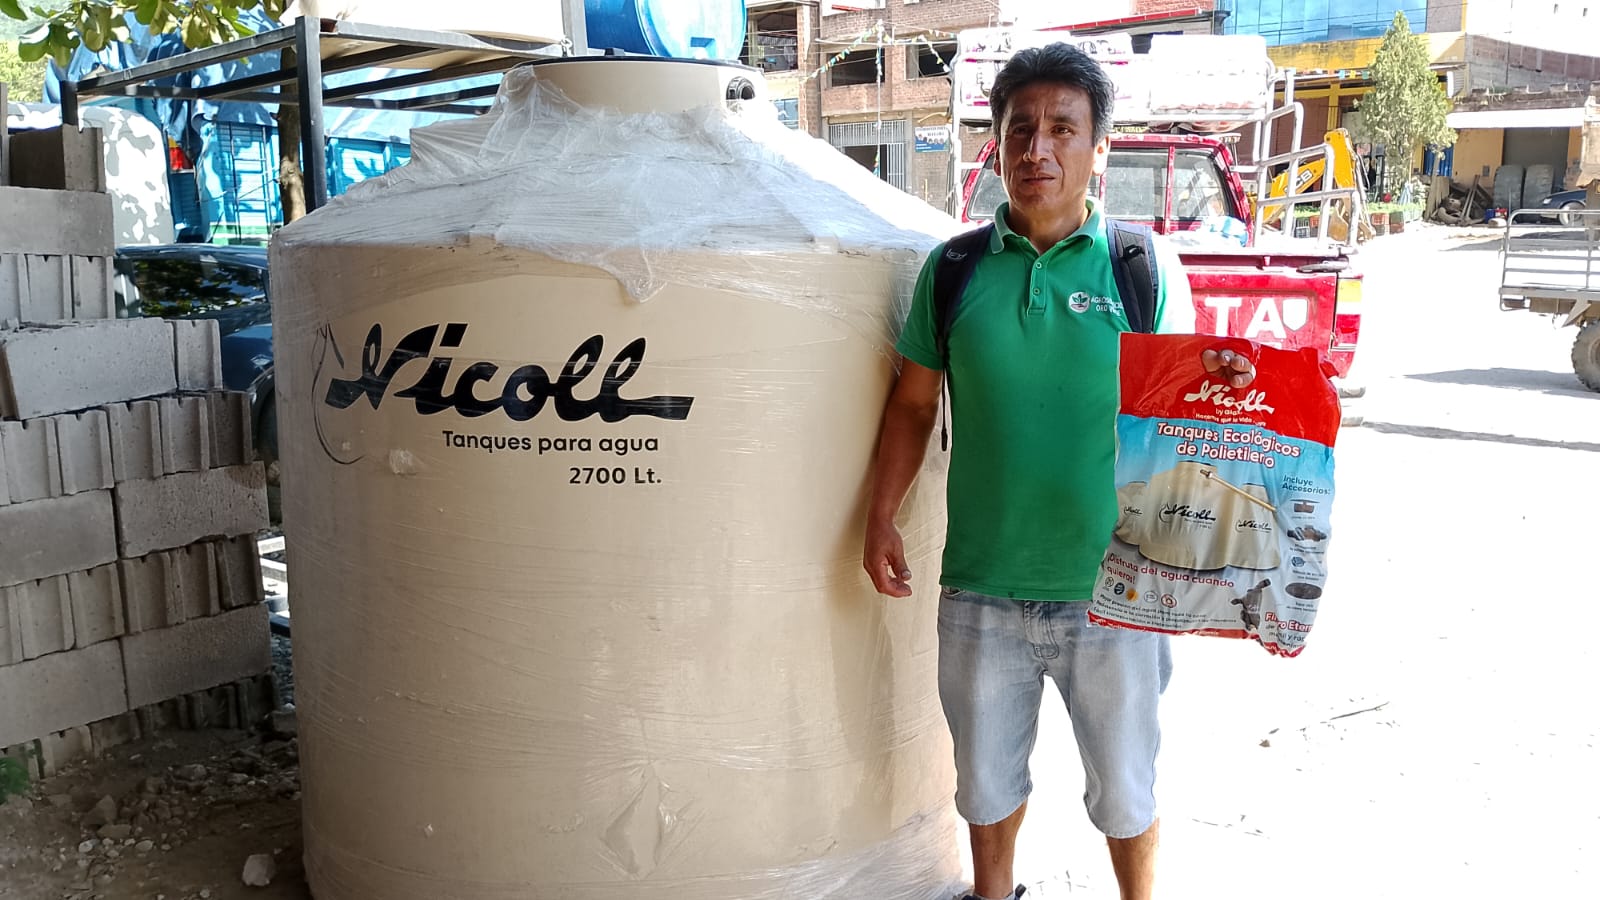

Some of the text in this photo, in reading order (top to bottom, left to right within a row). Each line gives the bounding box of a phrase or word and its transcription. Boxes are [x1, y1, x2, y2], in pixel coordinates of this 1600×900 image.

[325, 322, 695, 423] Nicoll
[442, 430, 659, 456] Tanques para agua
[1157, 422, 1300, 457] Tanques Ecológicos
[1176, 442, 1197, 456] de
[569, 467, 662, 484] 2700 Lt.
[1283, 474, 1313, 486] Incluye
[1165, 502, 1217, 521] Nicoll
[1140, 566, 1158, 575] del
[1160, 570, 1190, 582] agua
[1191, 575, 1235, 588] cuando
